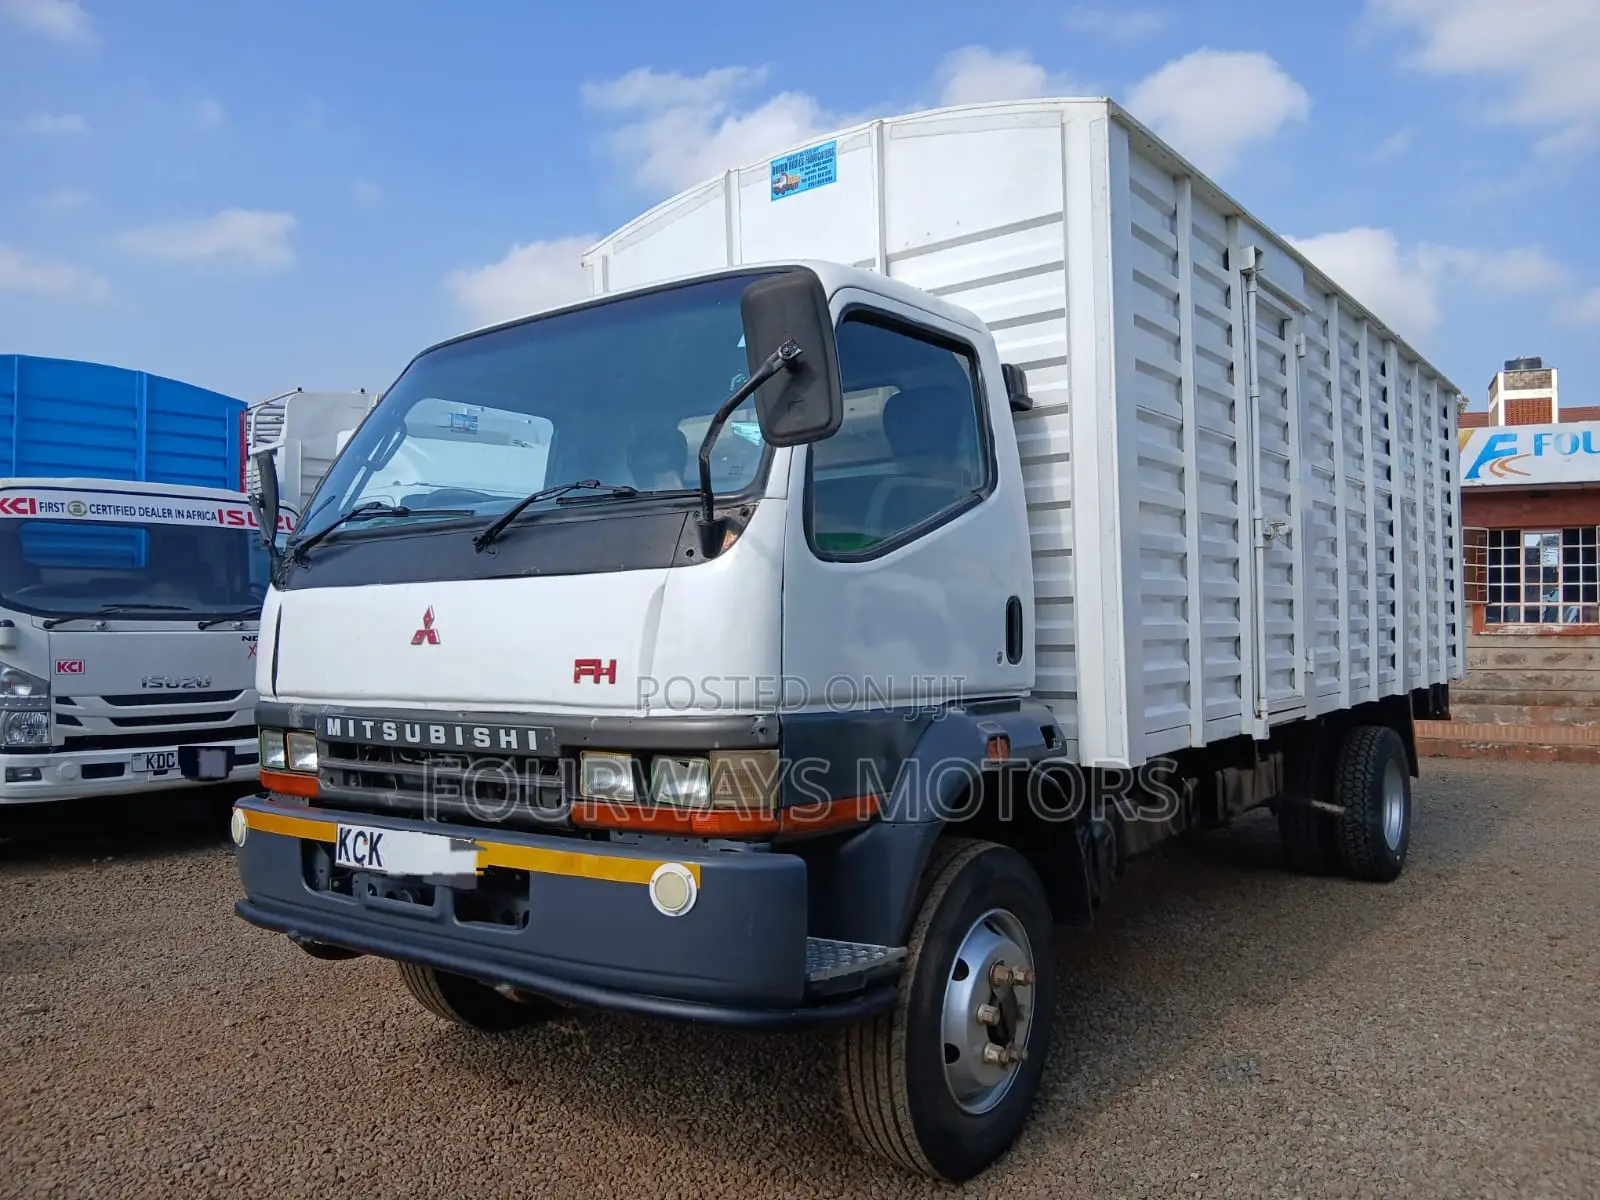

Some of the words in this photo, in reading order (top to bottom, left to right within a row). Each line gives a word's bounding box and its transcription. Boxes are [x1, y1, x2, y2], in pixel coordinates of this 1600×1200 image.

[39, 502, 65, 513] FIRST
[89, 504, 136, 516] CERTIFIED
[138, 507, 173, 519] DEALER
[175, 509, 184, 518] IN
[186, 510, 216, 521] AFRICA
[57, 661, 83, 673] KCI
[141, 675, 211, 689] ISUZU
[326, 717, 537, 751] MITSUBISHI
[146, 752, 176, 769] KDC
[337, 829, 383, 868] KCK
